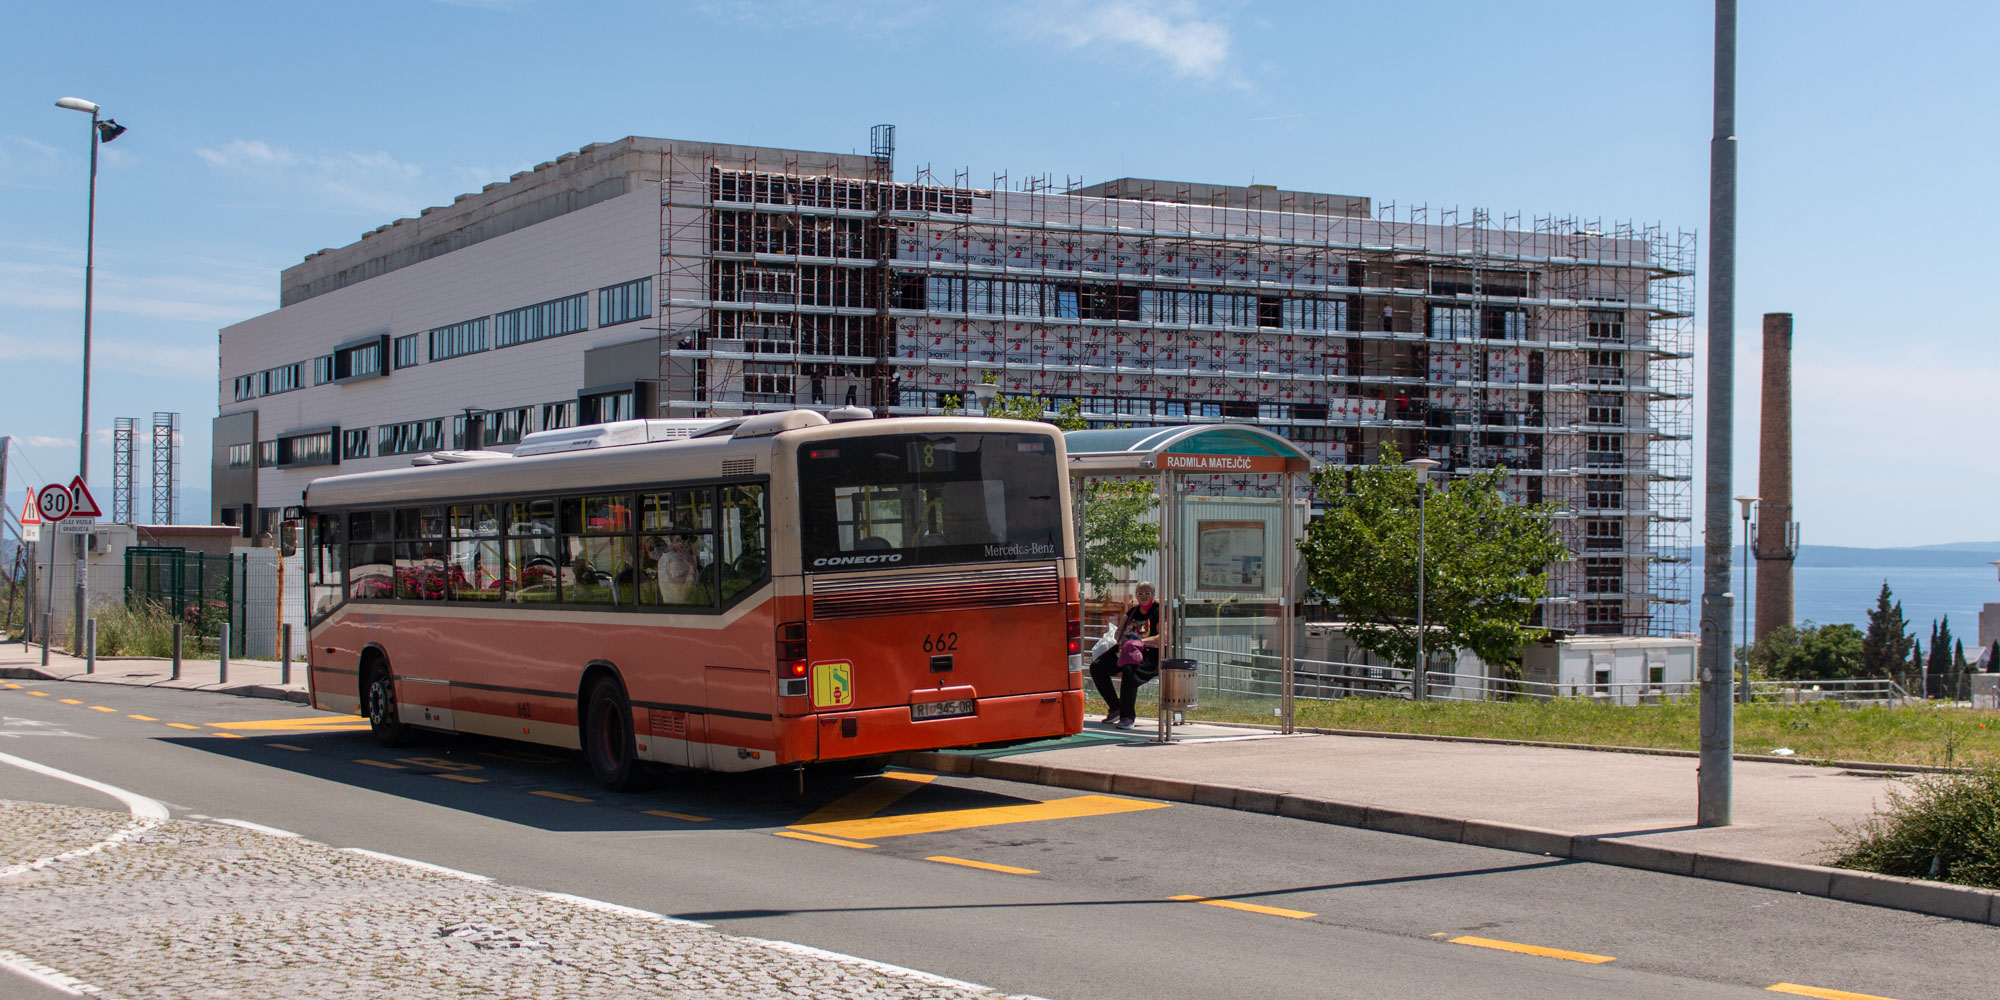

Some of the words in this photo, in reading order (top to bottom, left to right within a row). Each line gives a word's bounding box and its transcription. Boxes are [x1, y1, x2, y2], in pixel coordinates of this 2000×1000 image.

[924, 444, 934, 468] 8
[1167, 456, 1208, 468] RADMILA
[1209, 456, 1252, 469] MATEJČIĆ
[44, 493, 65, 512] 30
[984, 542, 1055, 557] Mercedes-Benz
[813, 553, 903, 567] CONECTO
[923, 631, 958, 653] 662
[917, 704, 929, 716] RI
